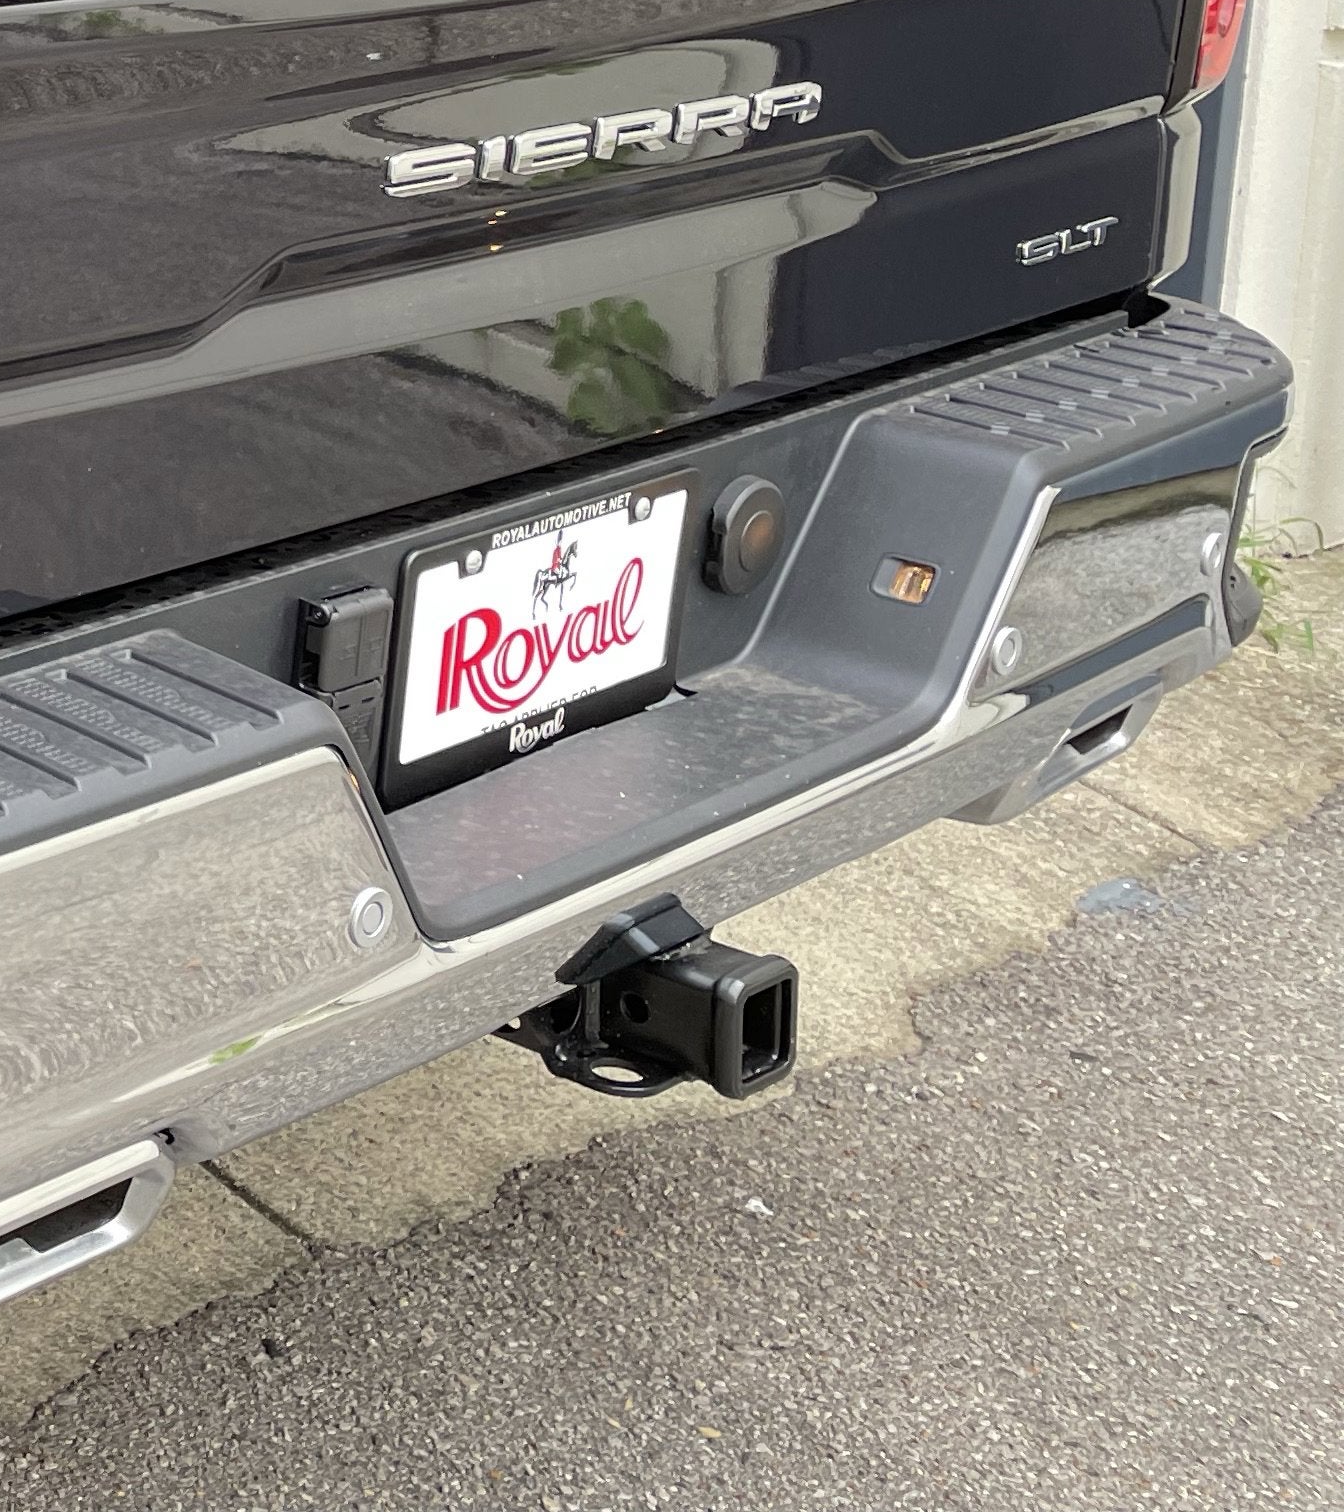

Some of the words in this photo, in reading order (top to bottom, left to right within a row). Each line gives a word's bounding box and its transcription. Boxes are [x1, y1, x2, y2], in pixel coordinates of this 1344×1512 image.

[381, 82, 823, 198] SIERRA
[1016, 216, 1119, 266] SLT
[491, 492, 632, 549] ROYALAUTOMOTIVE.NET
[435, 557, 644, 716] Royal
[509, 706, 565, 754] Royal
